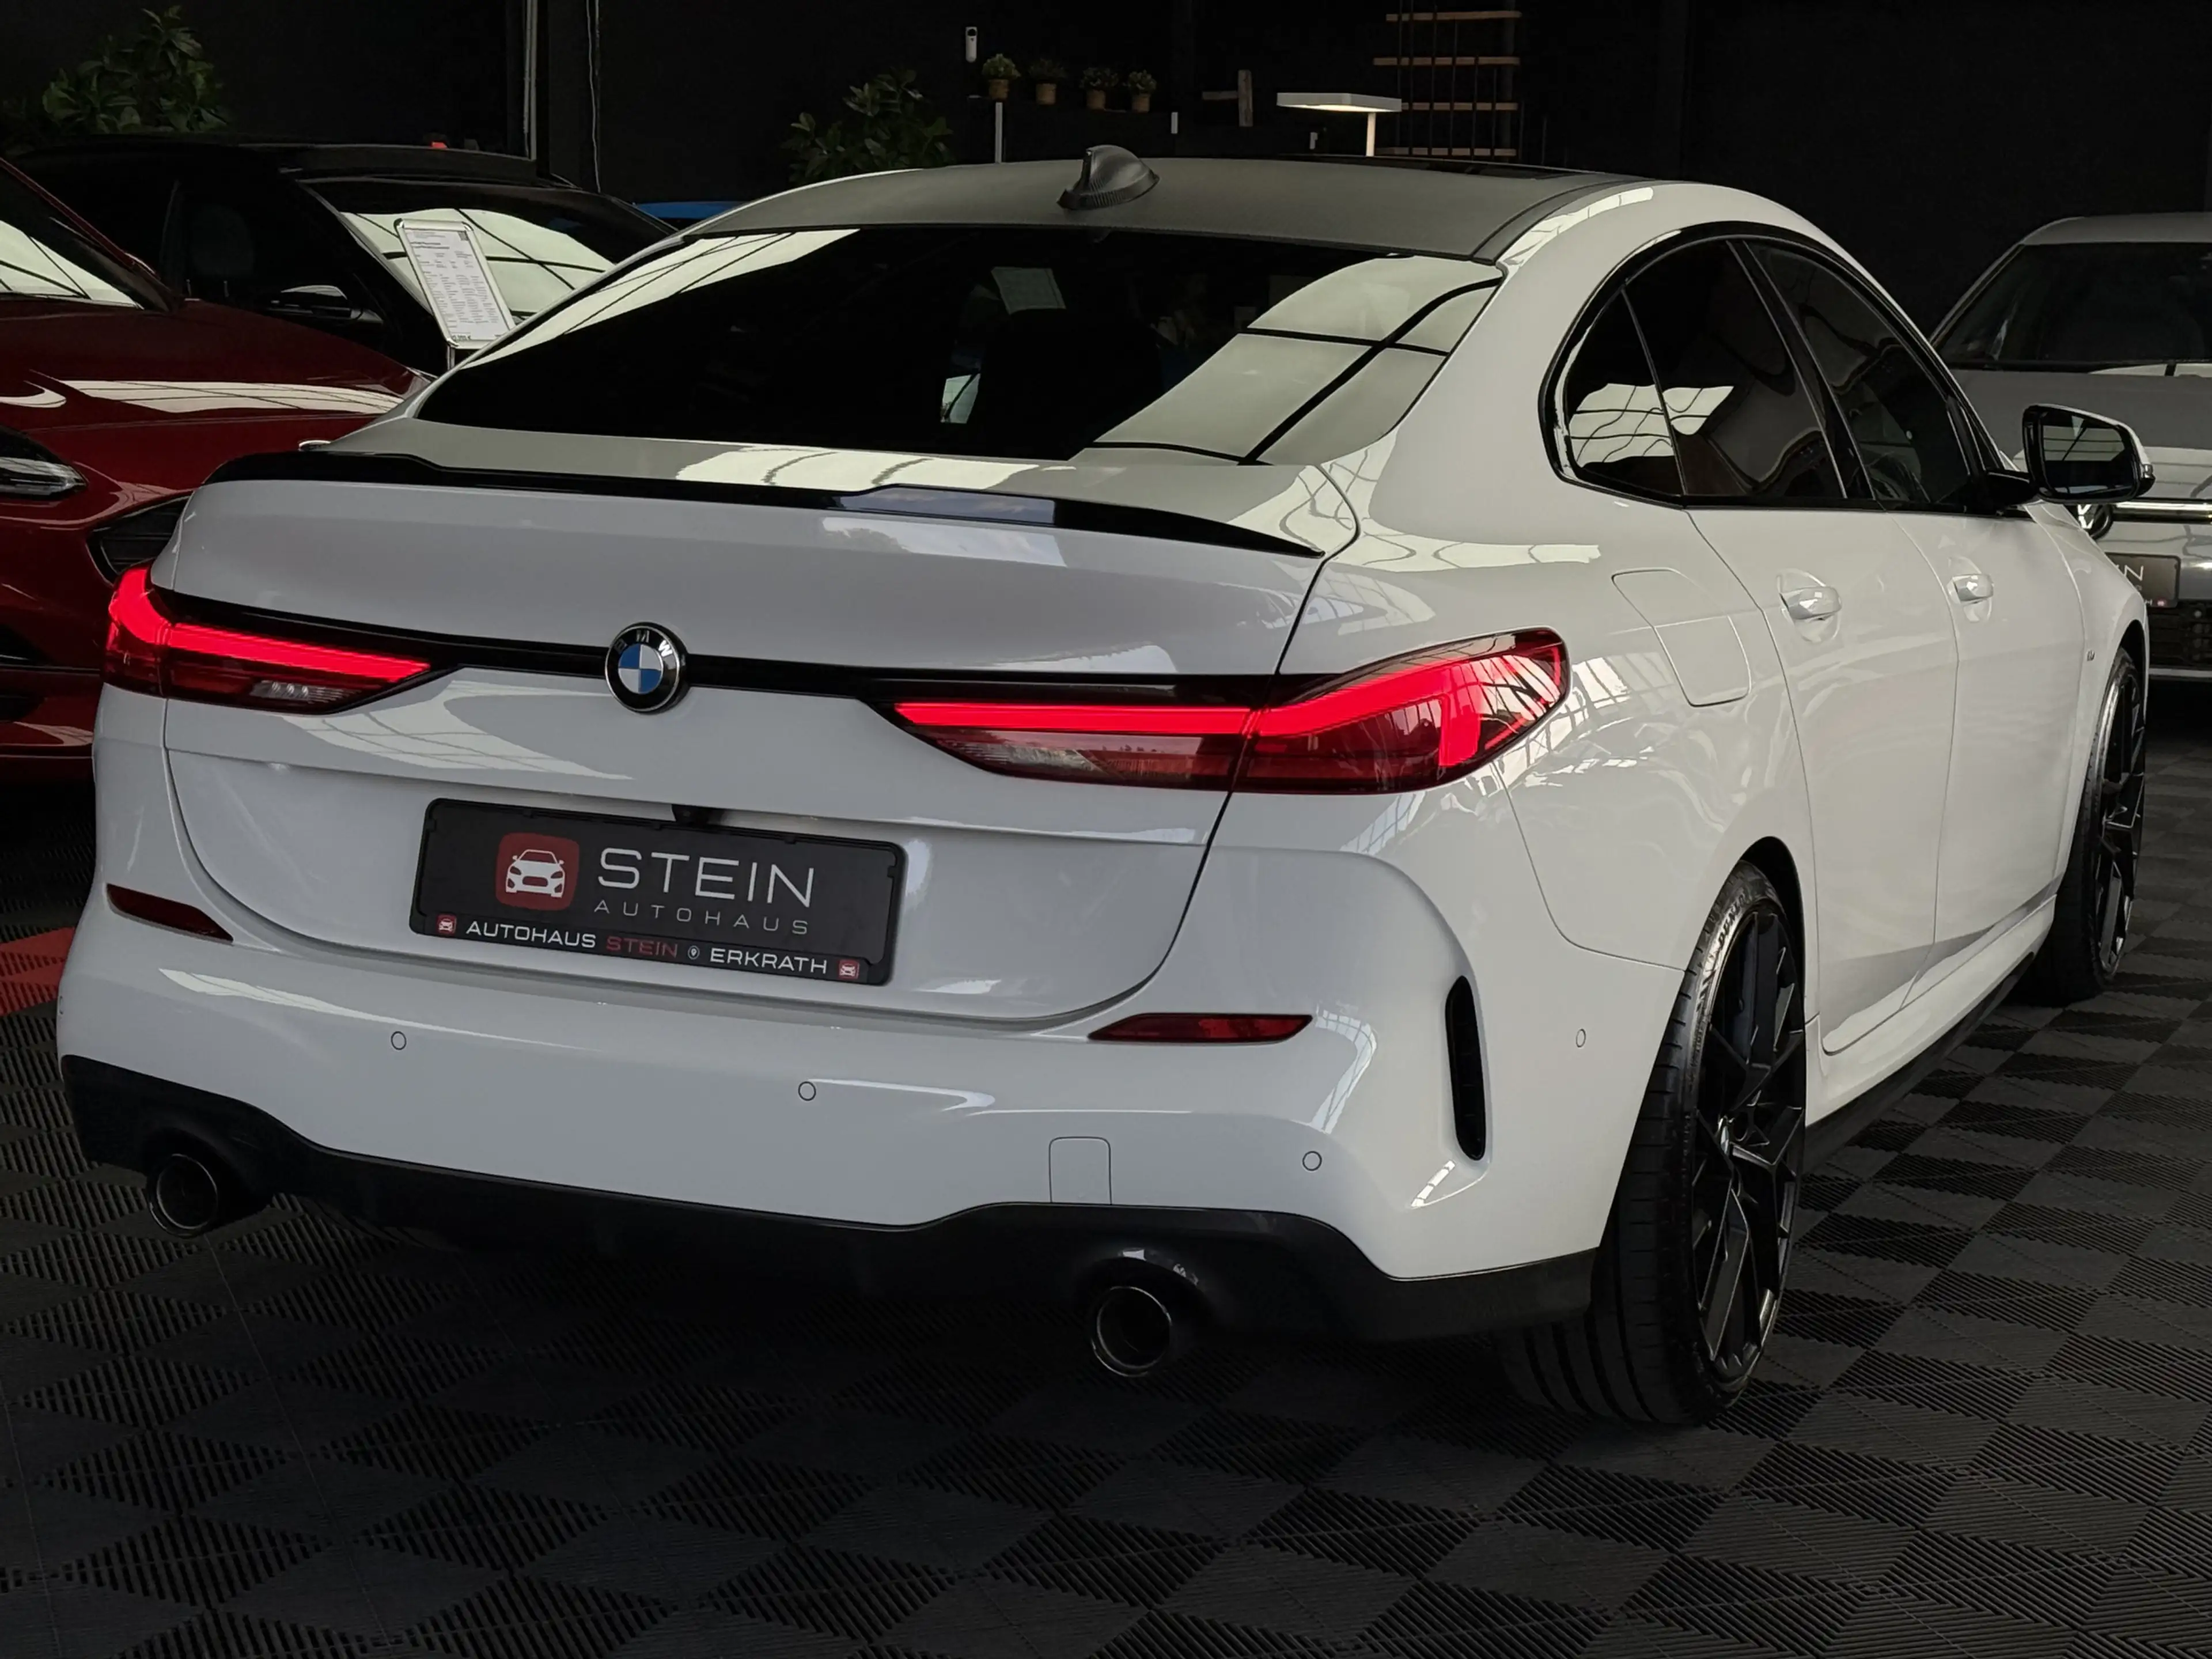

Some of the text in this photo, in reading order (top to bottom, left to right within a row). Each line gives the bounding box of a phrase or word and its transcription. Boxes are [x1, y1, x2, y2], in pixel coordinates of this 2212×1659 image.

[613, 630, 673, 657] BMW
[598, 847, 814, 908] STEIN
[594, 900, 808, 935] AUTOHAUS
[465, 921, 827, 974] AUTOHAUS STEIN ERKRATH
